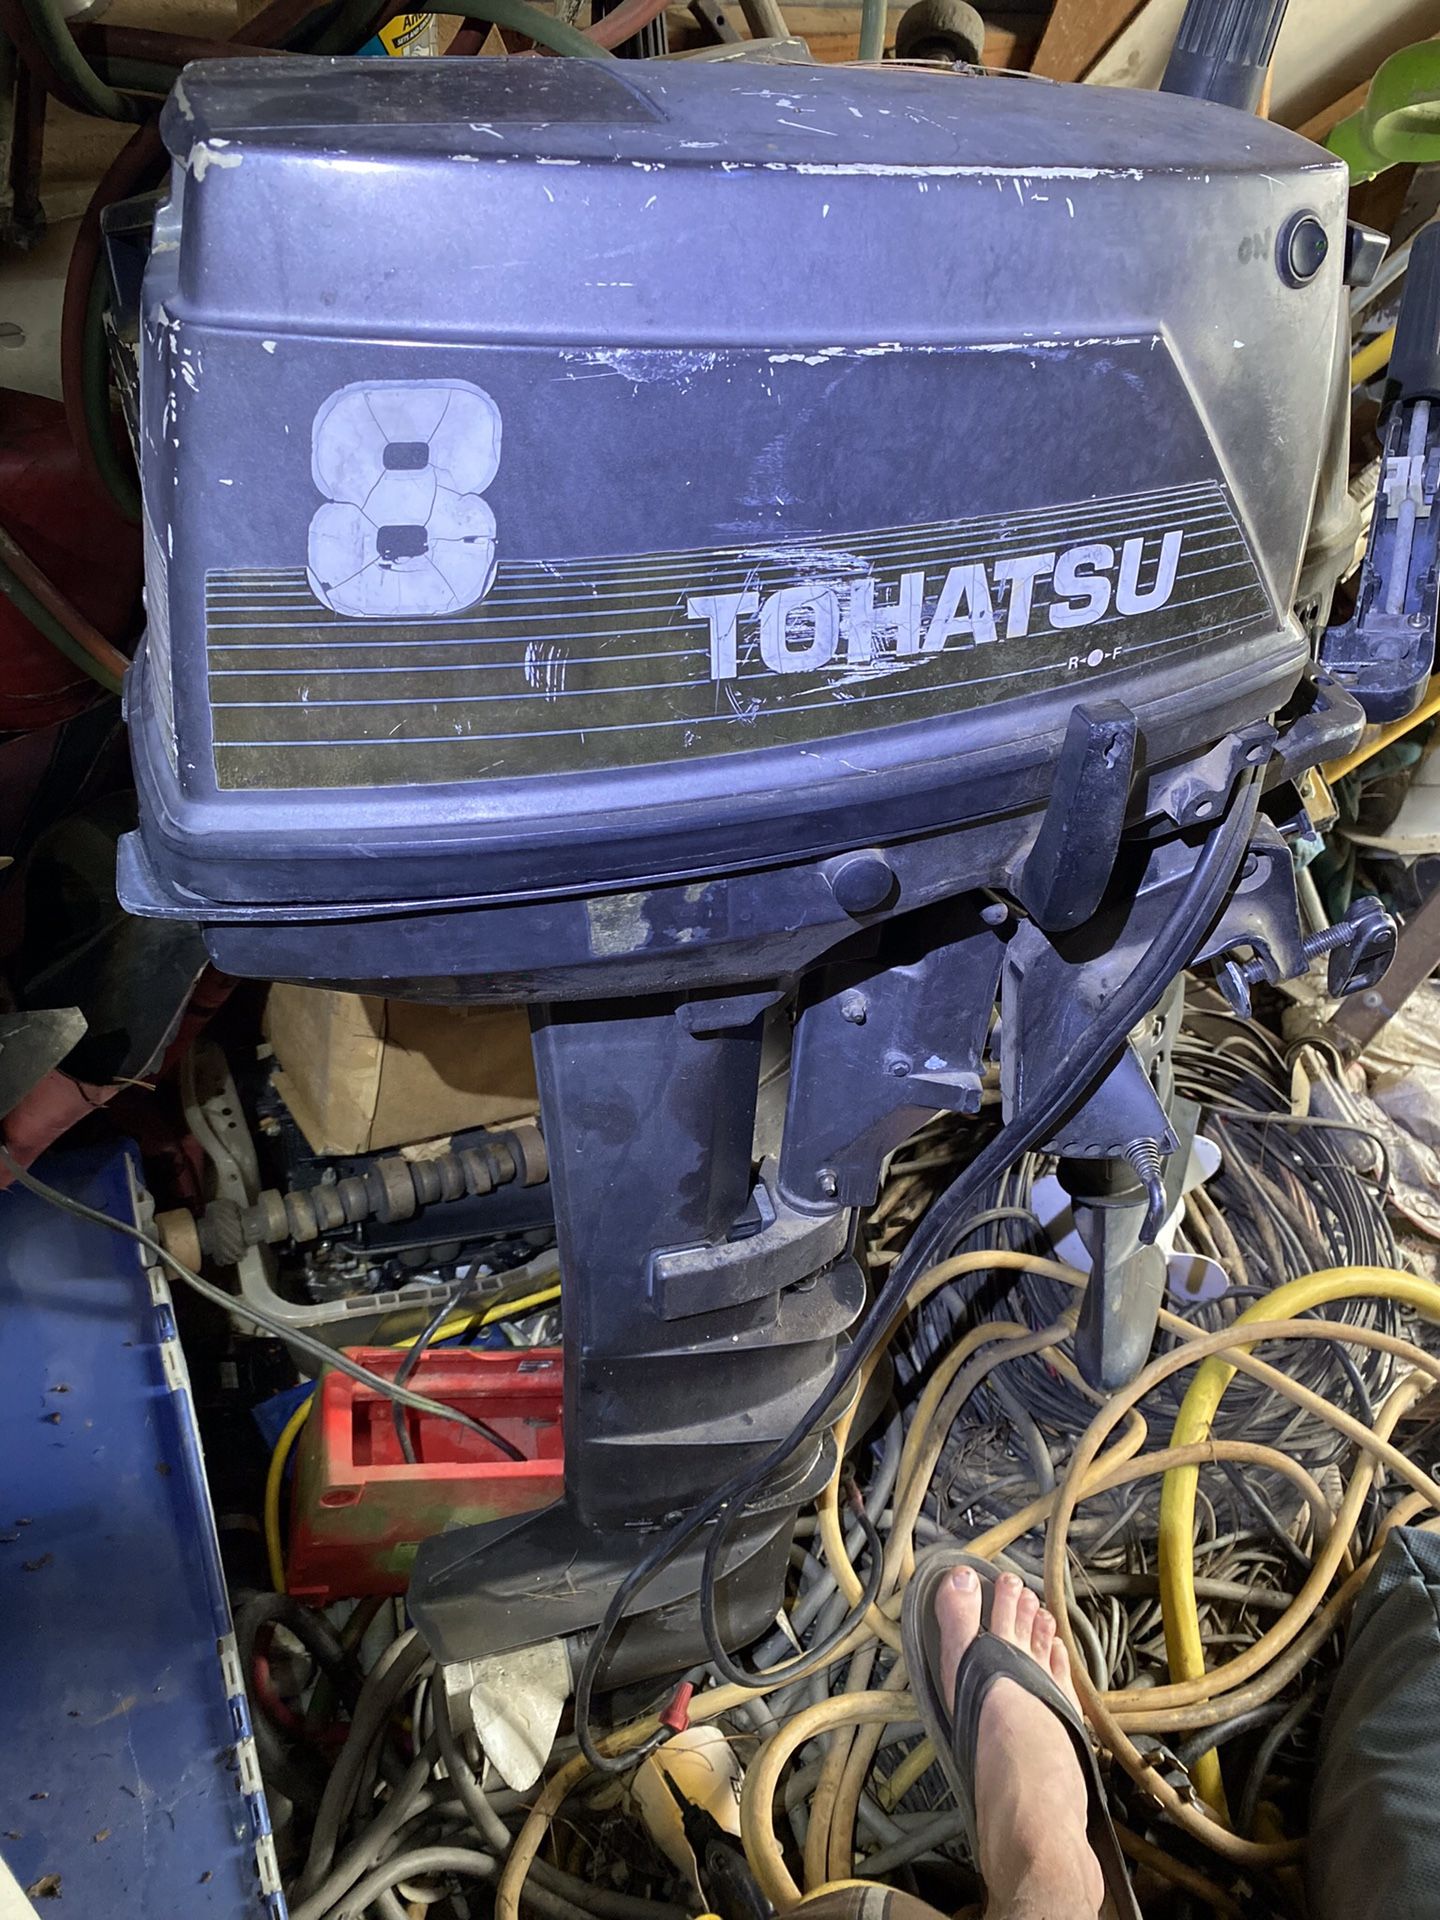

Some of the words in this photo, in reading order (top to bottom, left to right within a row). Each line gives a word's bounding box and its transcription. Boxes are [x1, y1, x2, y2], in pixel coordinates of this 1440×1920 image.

[1238, 226, 1272, 265] ON
[308, 378, 502, 617] 8
[687, 530, 1184, 680] TOHATSU
[1068, 656, 1079, 670] R
[1112, 646, 1122, 660] F
